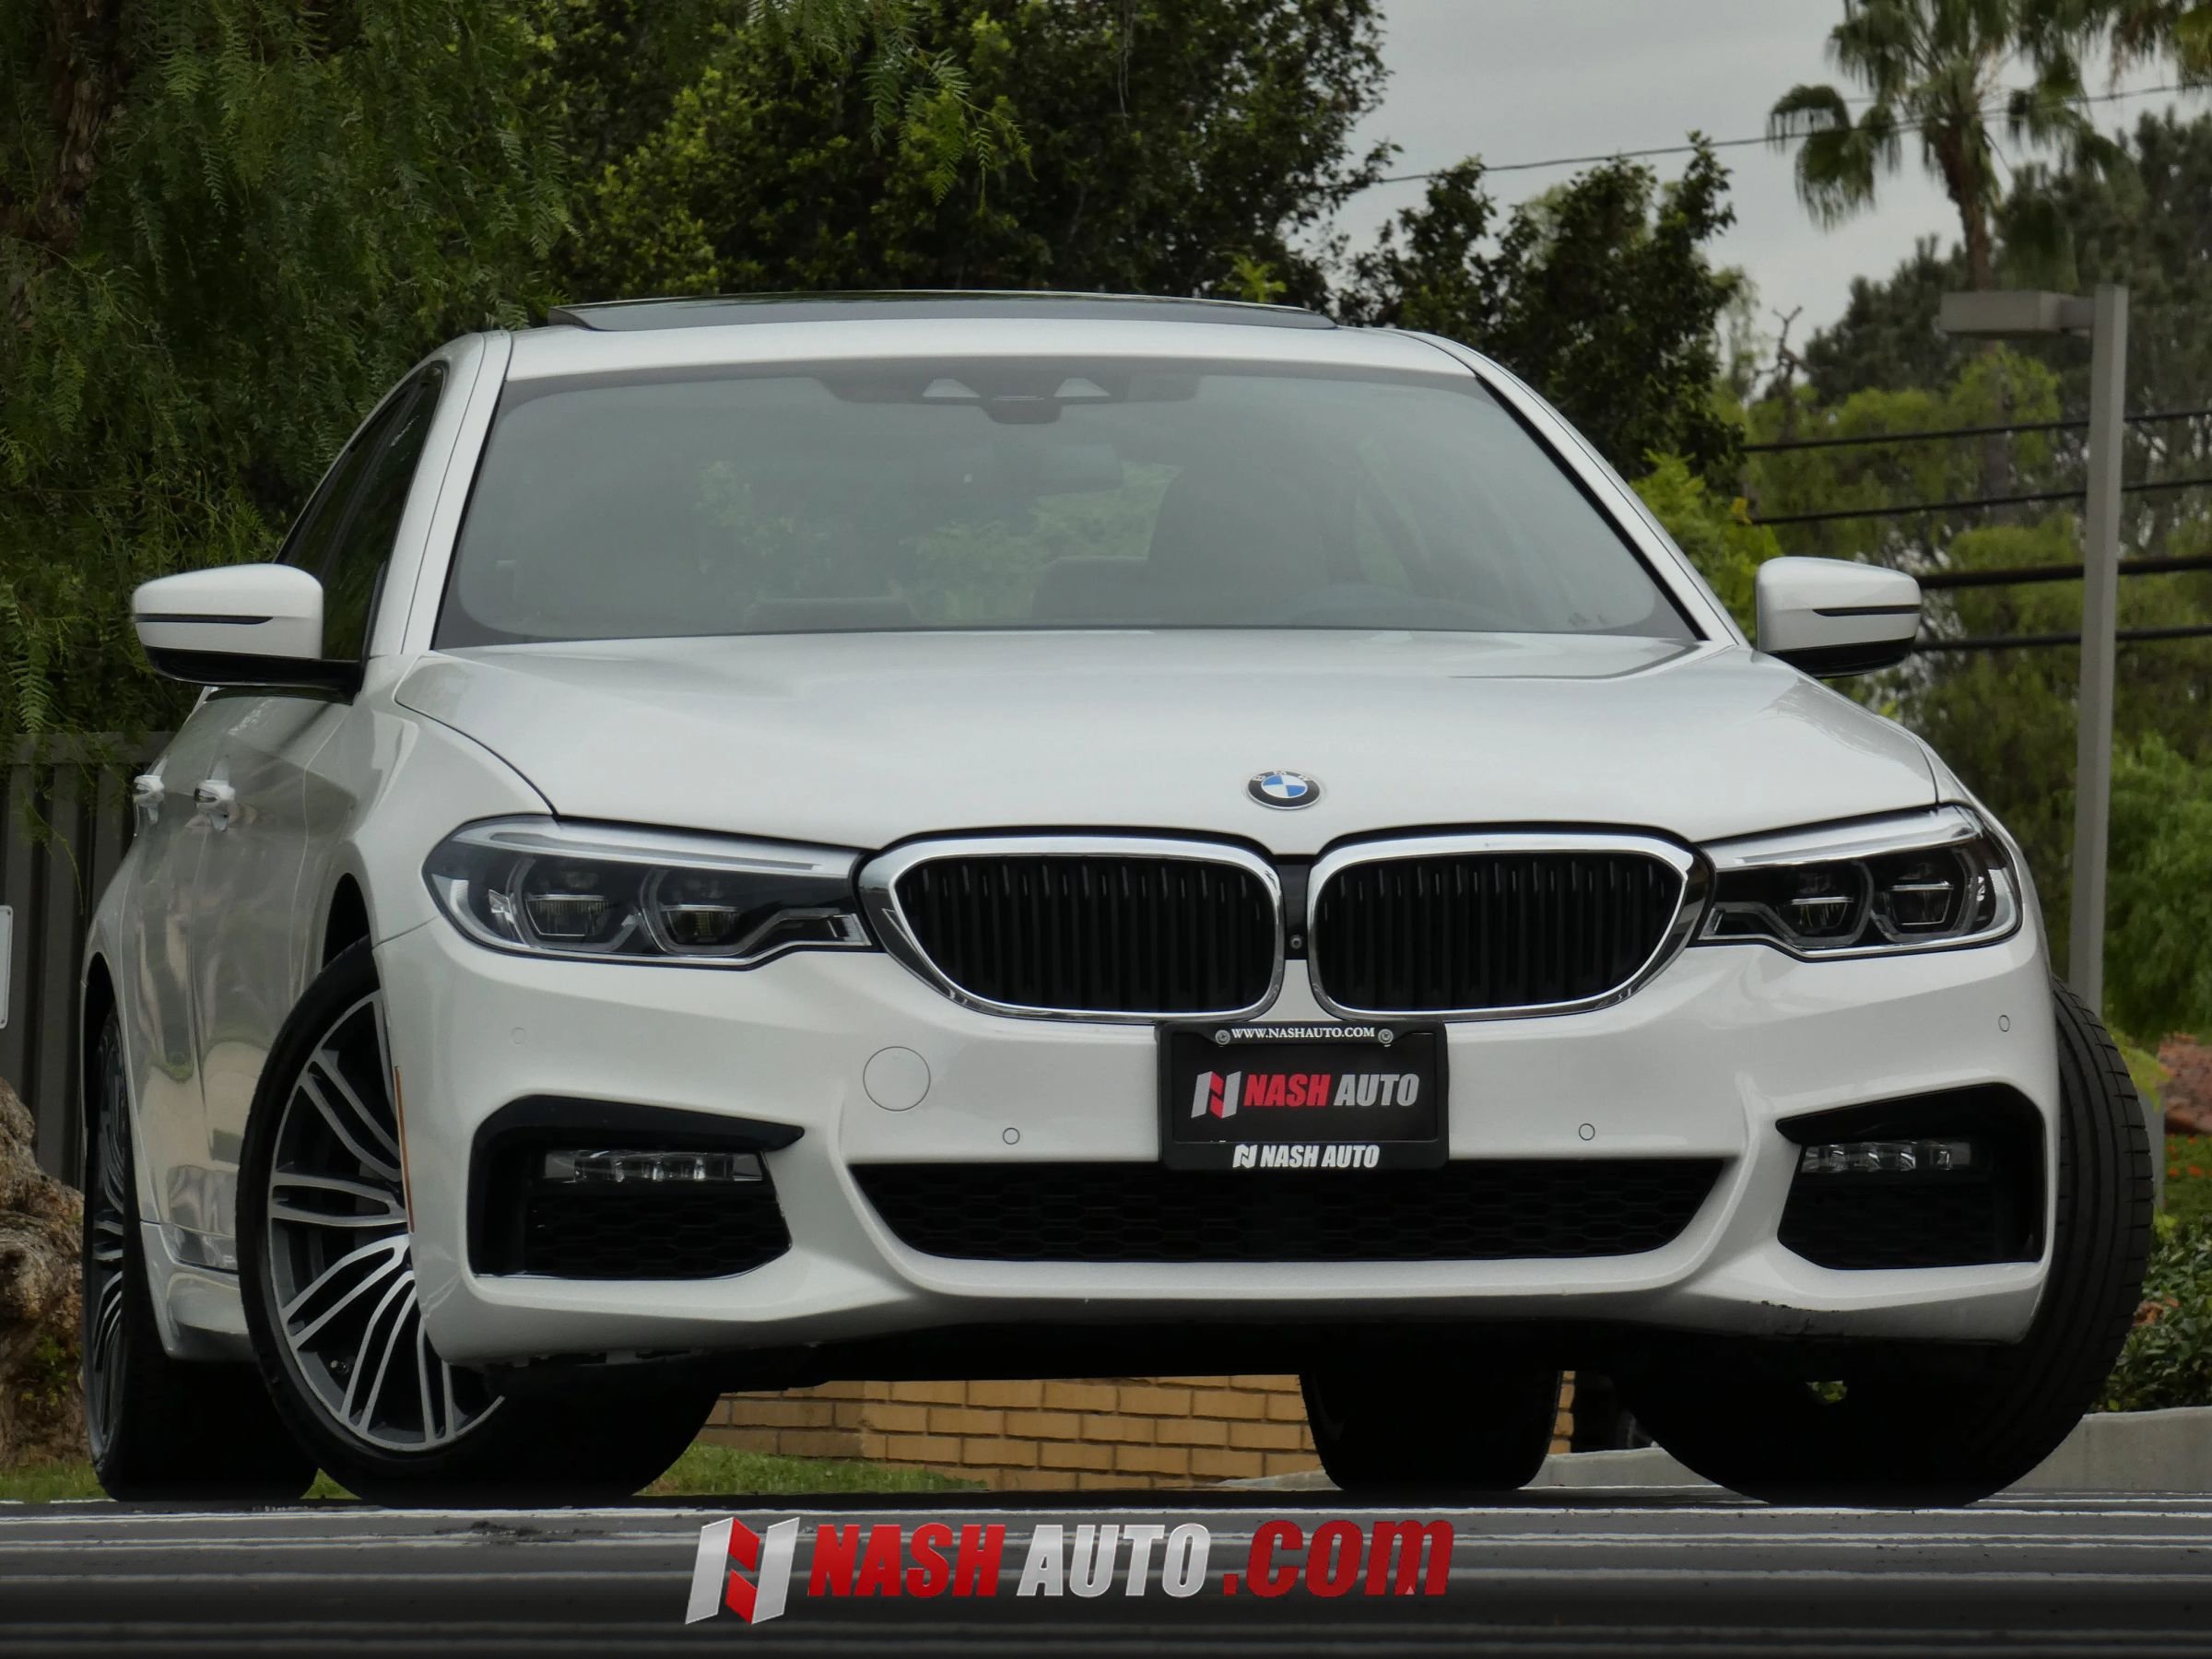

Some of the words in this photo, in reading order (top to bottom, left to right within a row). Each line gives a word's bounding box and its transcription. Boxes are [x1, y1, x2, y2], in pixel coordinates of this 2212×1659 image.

[1231, 1027, 1375, 1039] WWW.NASHAUTO.COM
[1244, 1074, 1332, 1106] NASH
[1334, 1074, 1420, 1106] AUTO
[1260, 1146, 1319, 1168] NASH
[1322, 1145, 1380, 1168] AUTO
